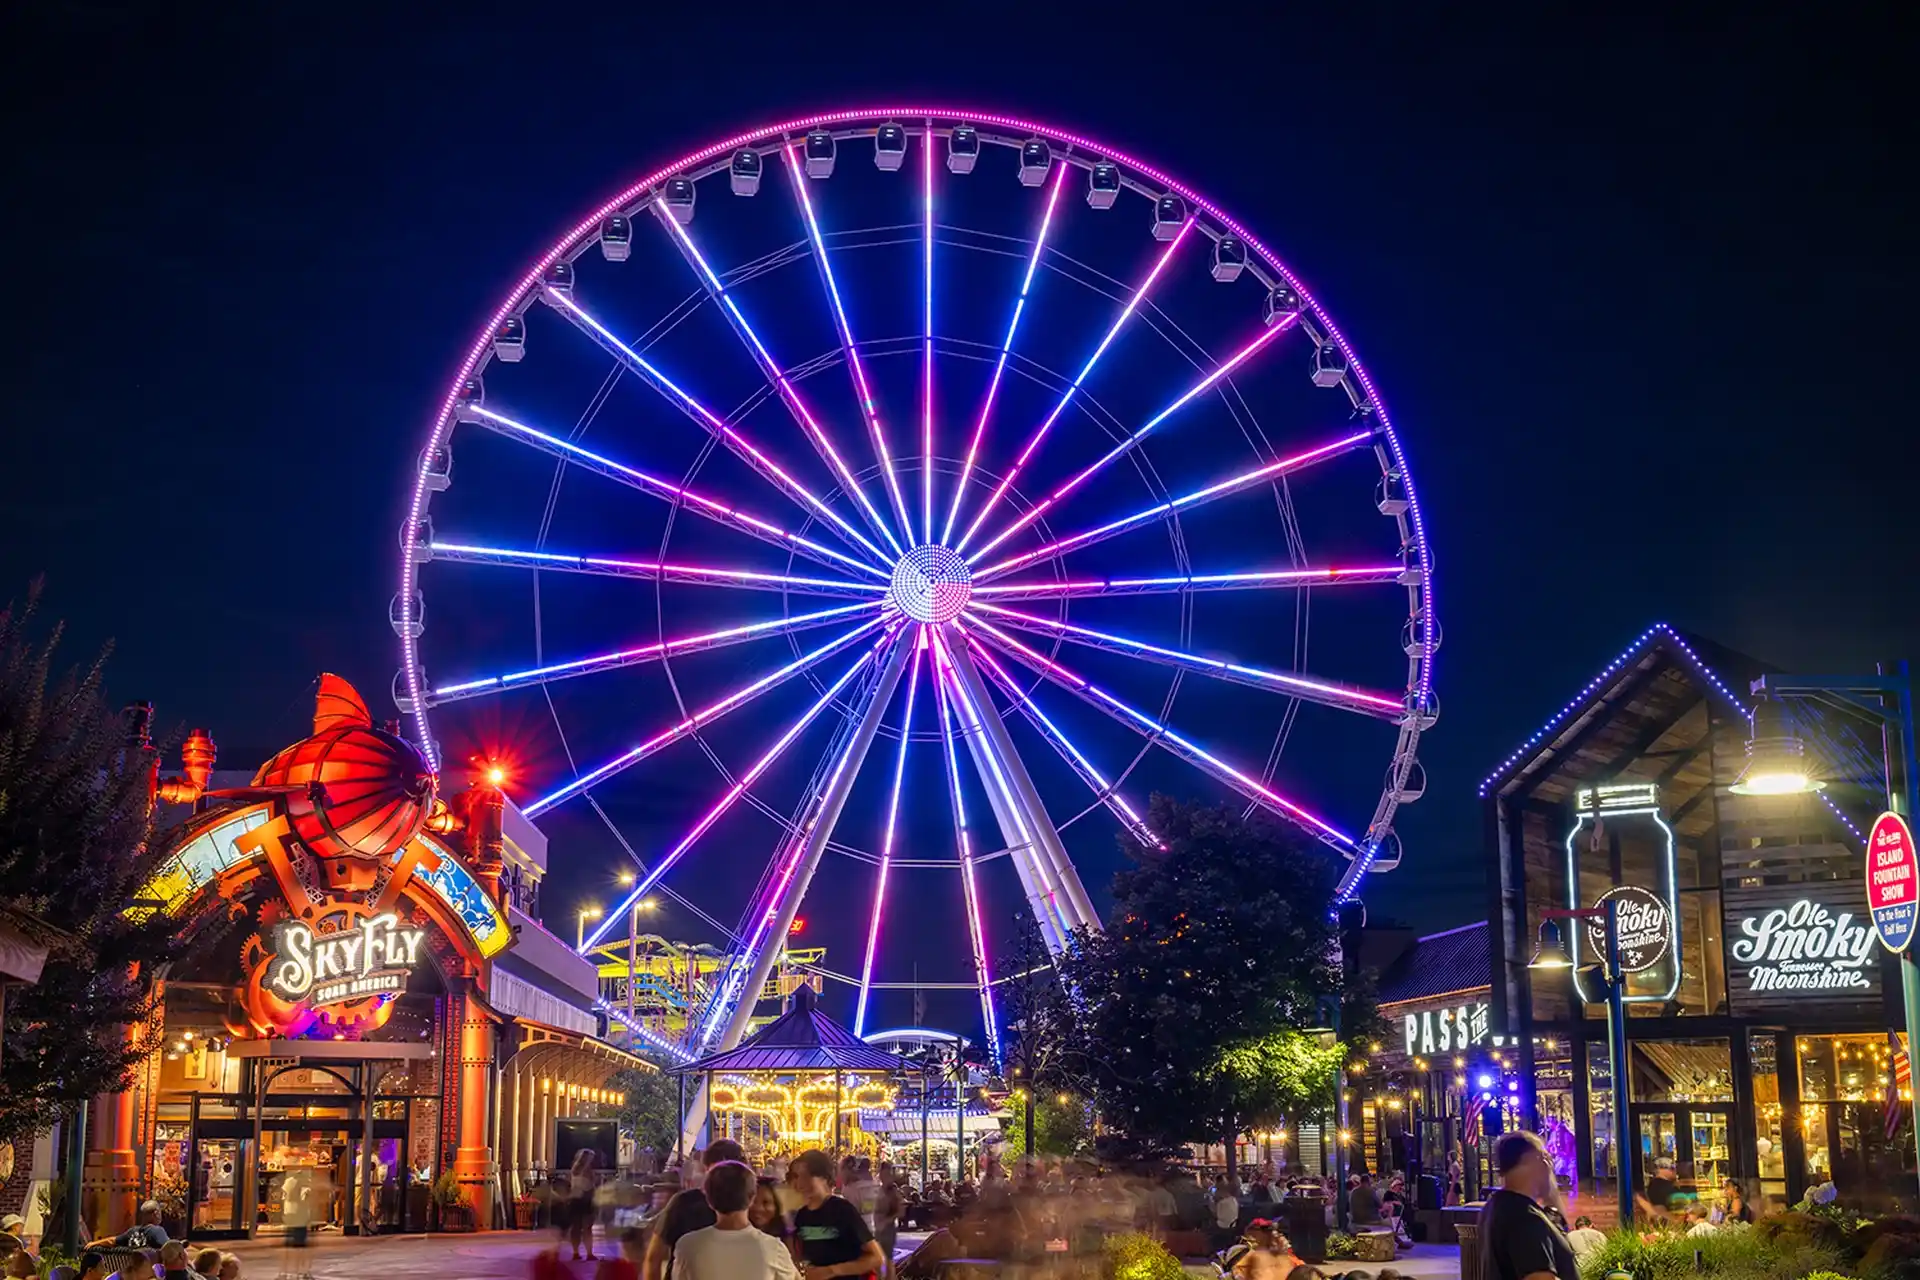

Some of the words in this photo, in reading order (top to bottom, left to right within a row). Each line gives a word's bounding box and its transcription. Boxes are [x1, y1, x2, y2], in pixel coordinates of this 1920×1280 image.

[1877, 848, 1904, 867] ISLAND
[1873, 865, 1910, 885] FOUNTAIN
[1881, 884, 1904, 902] SHOW
[1616, 899, 1643, 916] Ole
[1787, 899, 1836, 928] Ole
[1732, 909, 1878, 969] Smoky
[1749, 965, 1871, 991] Moonshine
[1779, 960, 1825, 973] Tennessee
[317, 983, 347, 1001] SOAR
[351, 975, 399, 993] AMERICA
[1405, 1006, 1468, 1056] PASS
[1470, 1008, 1488, 1038] THE
